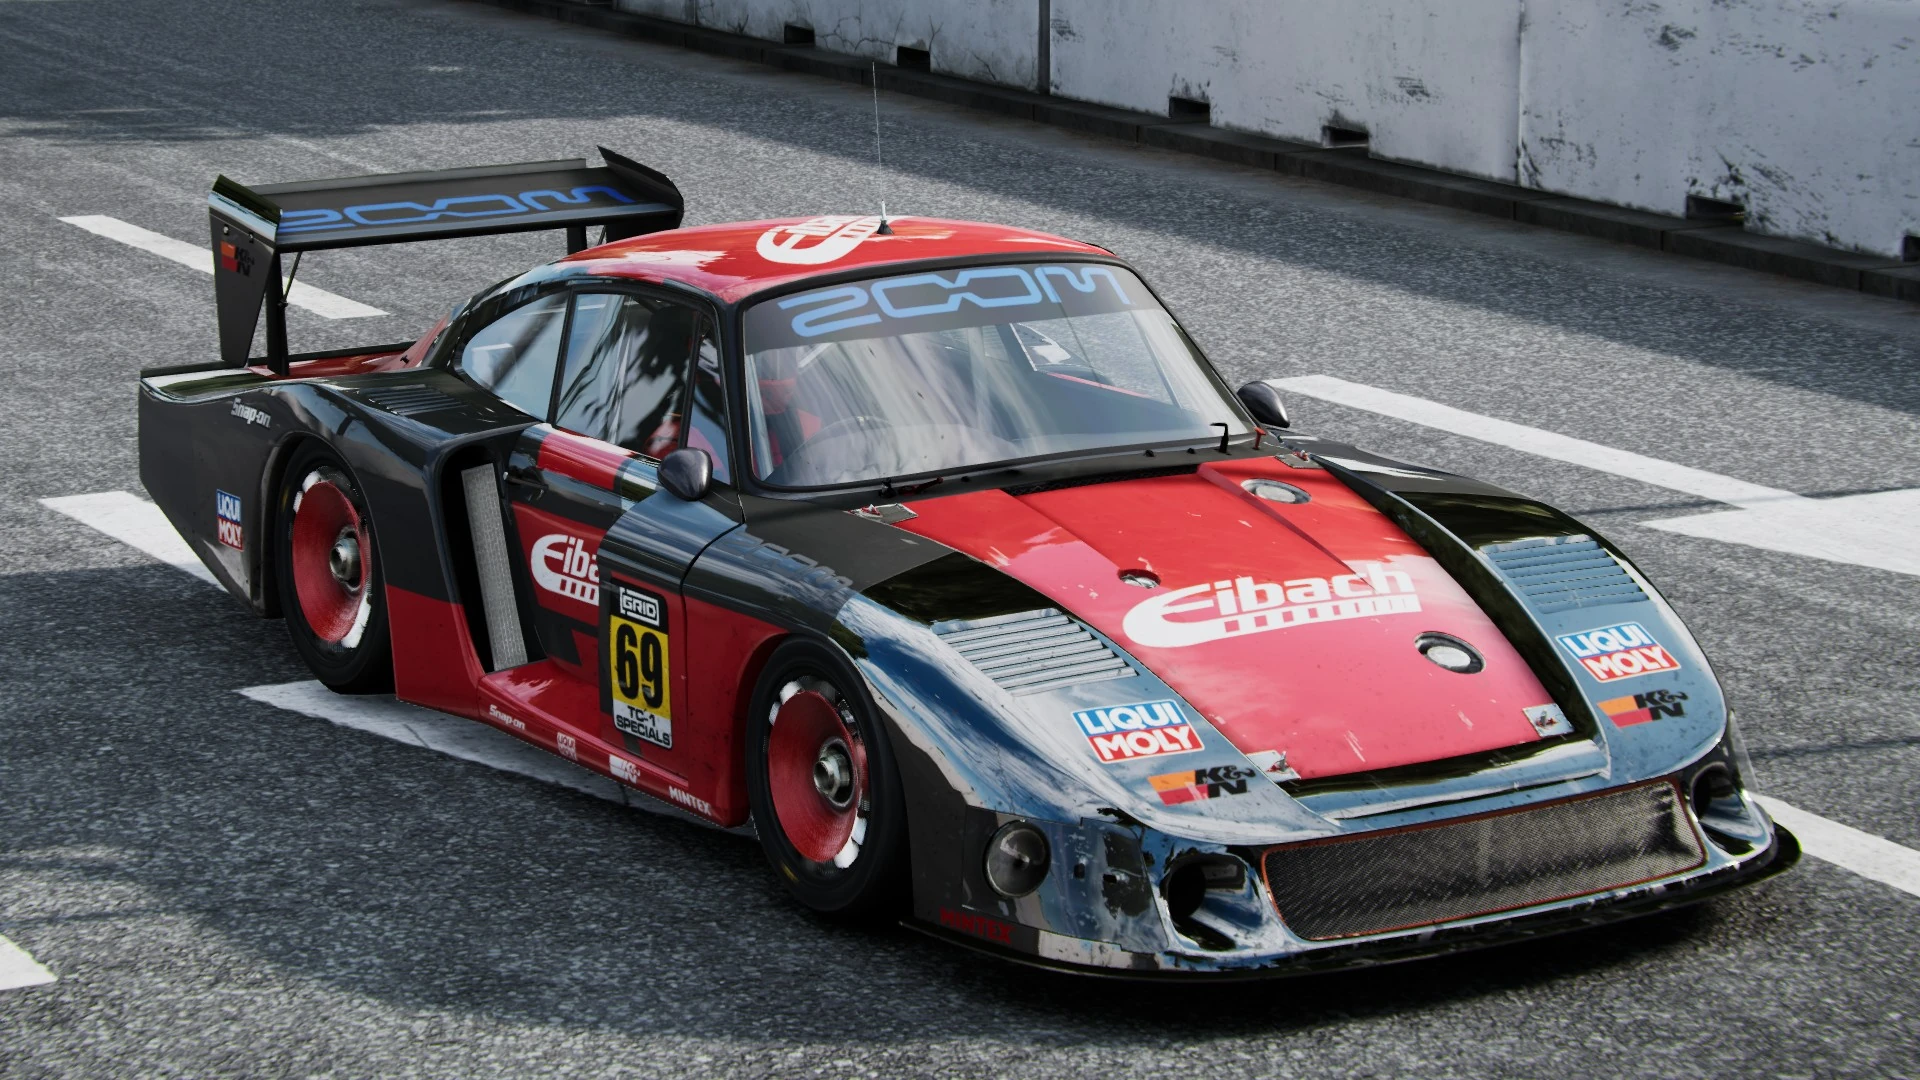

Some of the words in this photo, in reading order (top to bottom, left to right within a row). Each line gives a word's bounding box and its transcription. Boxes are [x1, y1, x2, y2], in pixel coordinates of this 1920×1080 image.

[231, 398, 271, 428] Snap-on
[217, 493, 241, 522] LIQUI
[218, 520, 243, 548] MOLY
[622, 595, 657, 619] GRID
[1122, 561, 1423, 647] Eibach
[1562, 624, 1652, 658] LIQUI
[616, 623, 663, 709] 69
[1583, 645, 1671, 680] MOLY
[489, 704, 526, 730] Snap-on
[627, 705, 656, 727] TC-1
[1078, 702, 1182, 735] LIQUI
[1634, 689, 1688, 721] K&N
[616, 714, 670, 746] SPECIALS
[1093, 726, 1193, 760] MOLY
[1195, 764, 1256, 799] K&N
[669, 785, 712, 816] MINTEX
[939, 906, 1016, 945] MINTEX
